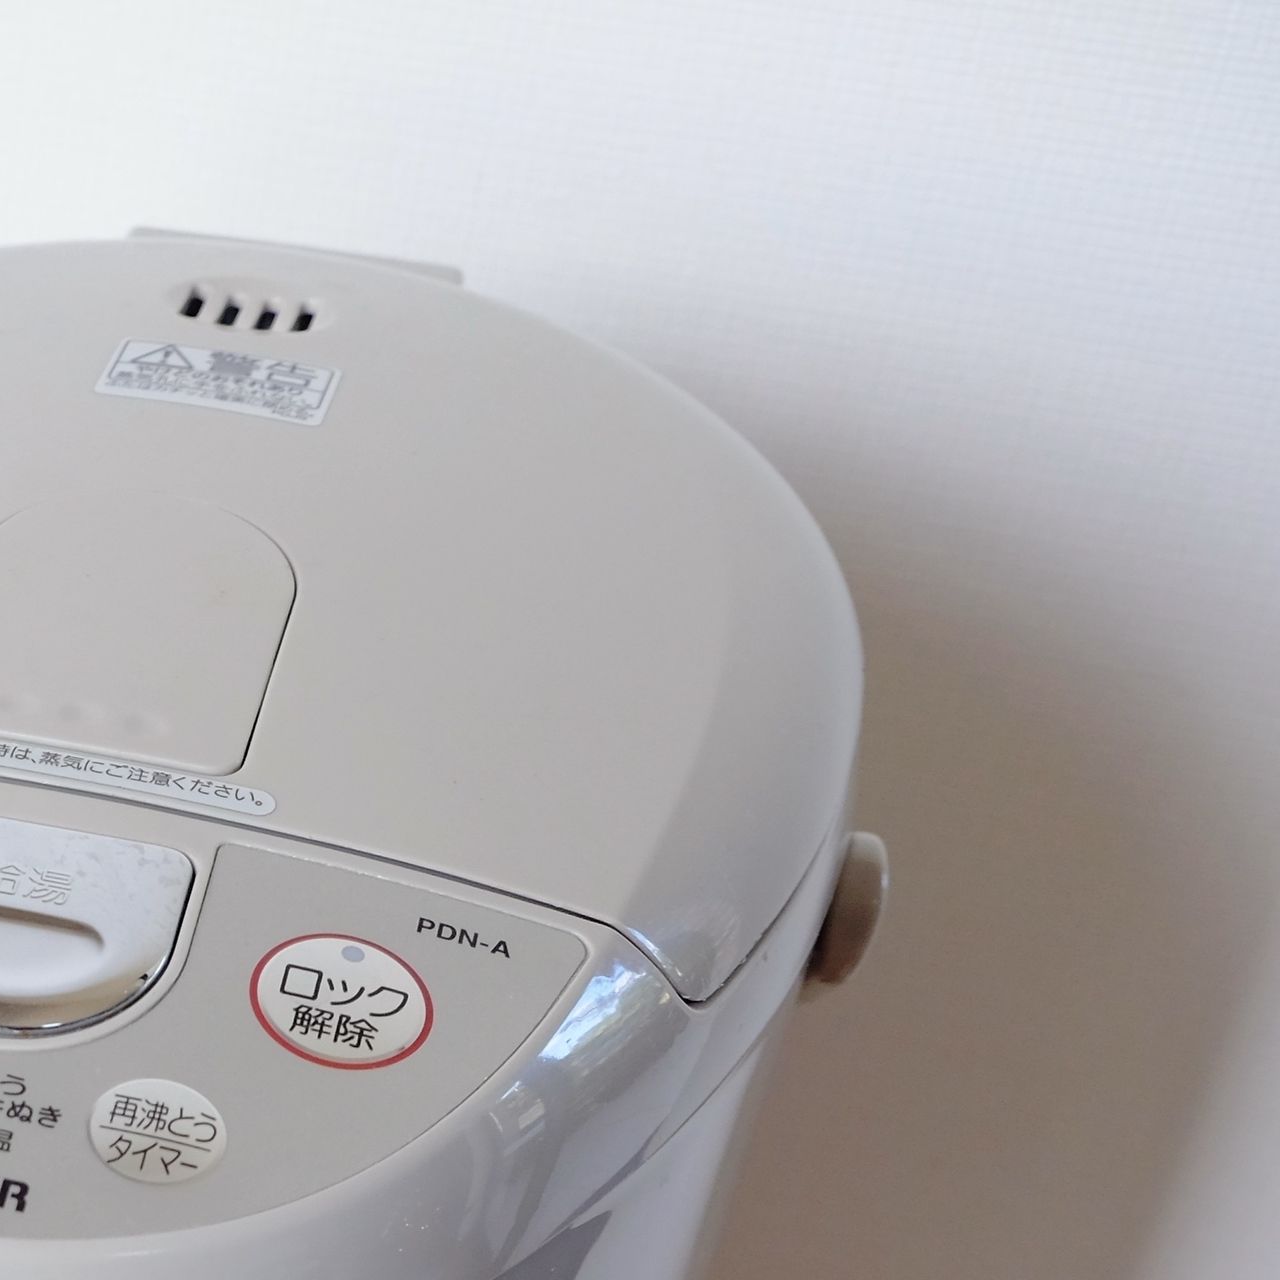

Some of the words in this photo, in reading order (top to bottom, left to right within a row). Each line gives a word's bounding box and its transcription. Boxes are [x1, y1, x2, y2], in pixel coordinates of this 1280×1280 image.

[415, 917, 512, 959] PDN-A
[279, 963, 409, 1018] ロック
[289, 1004, 379, 1051] 解除
[108, 1093, 219, 1144] 再沸とう
[106, 1135, 199, 1175] タイマー
